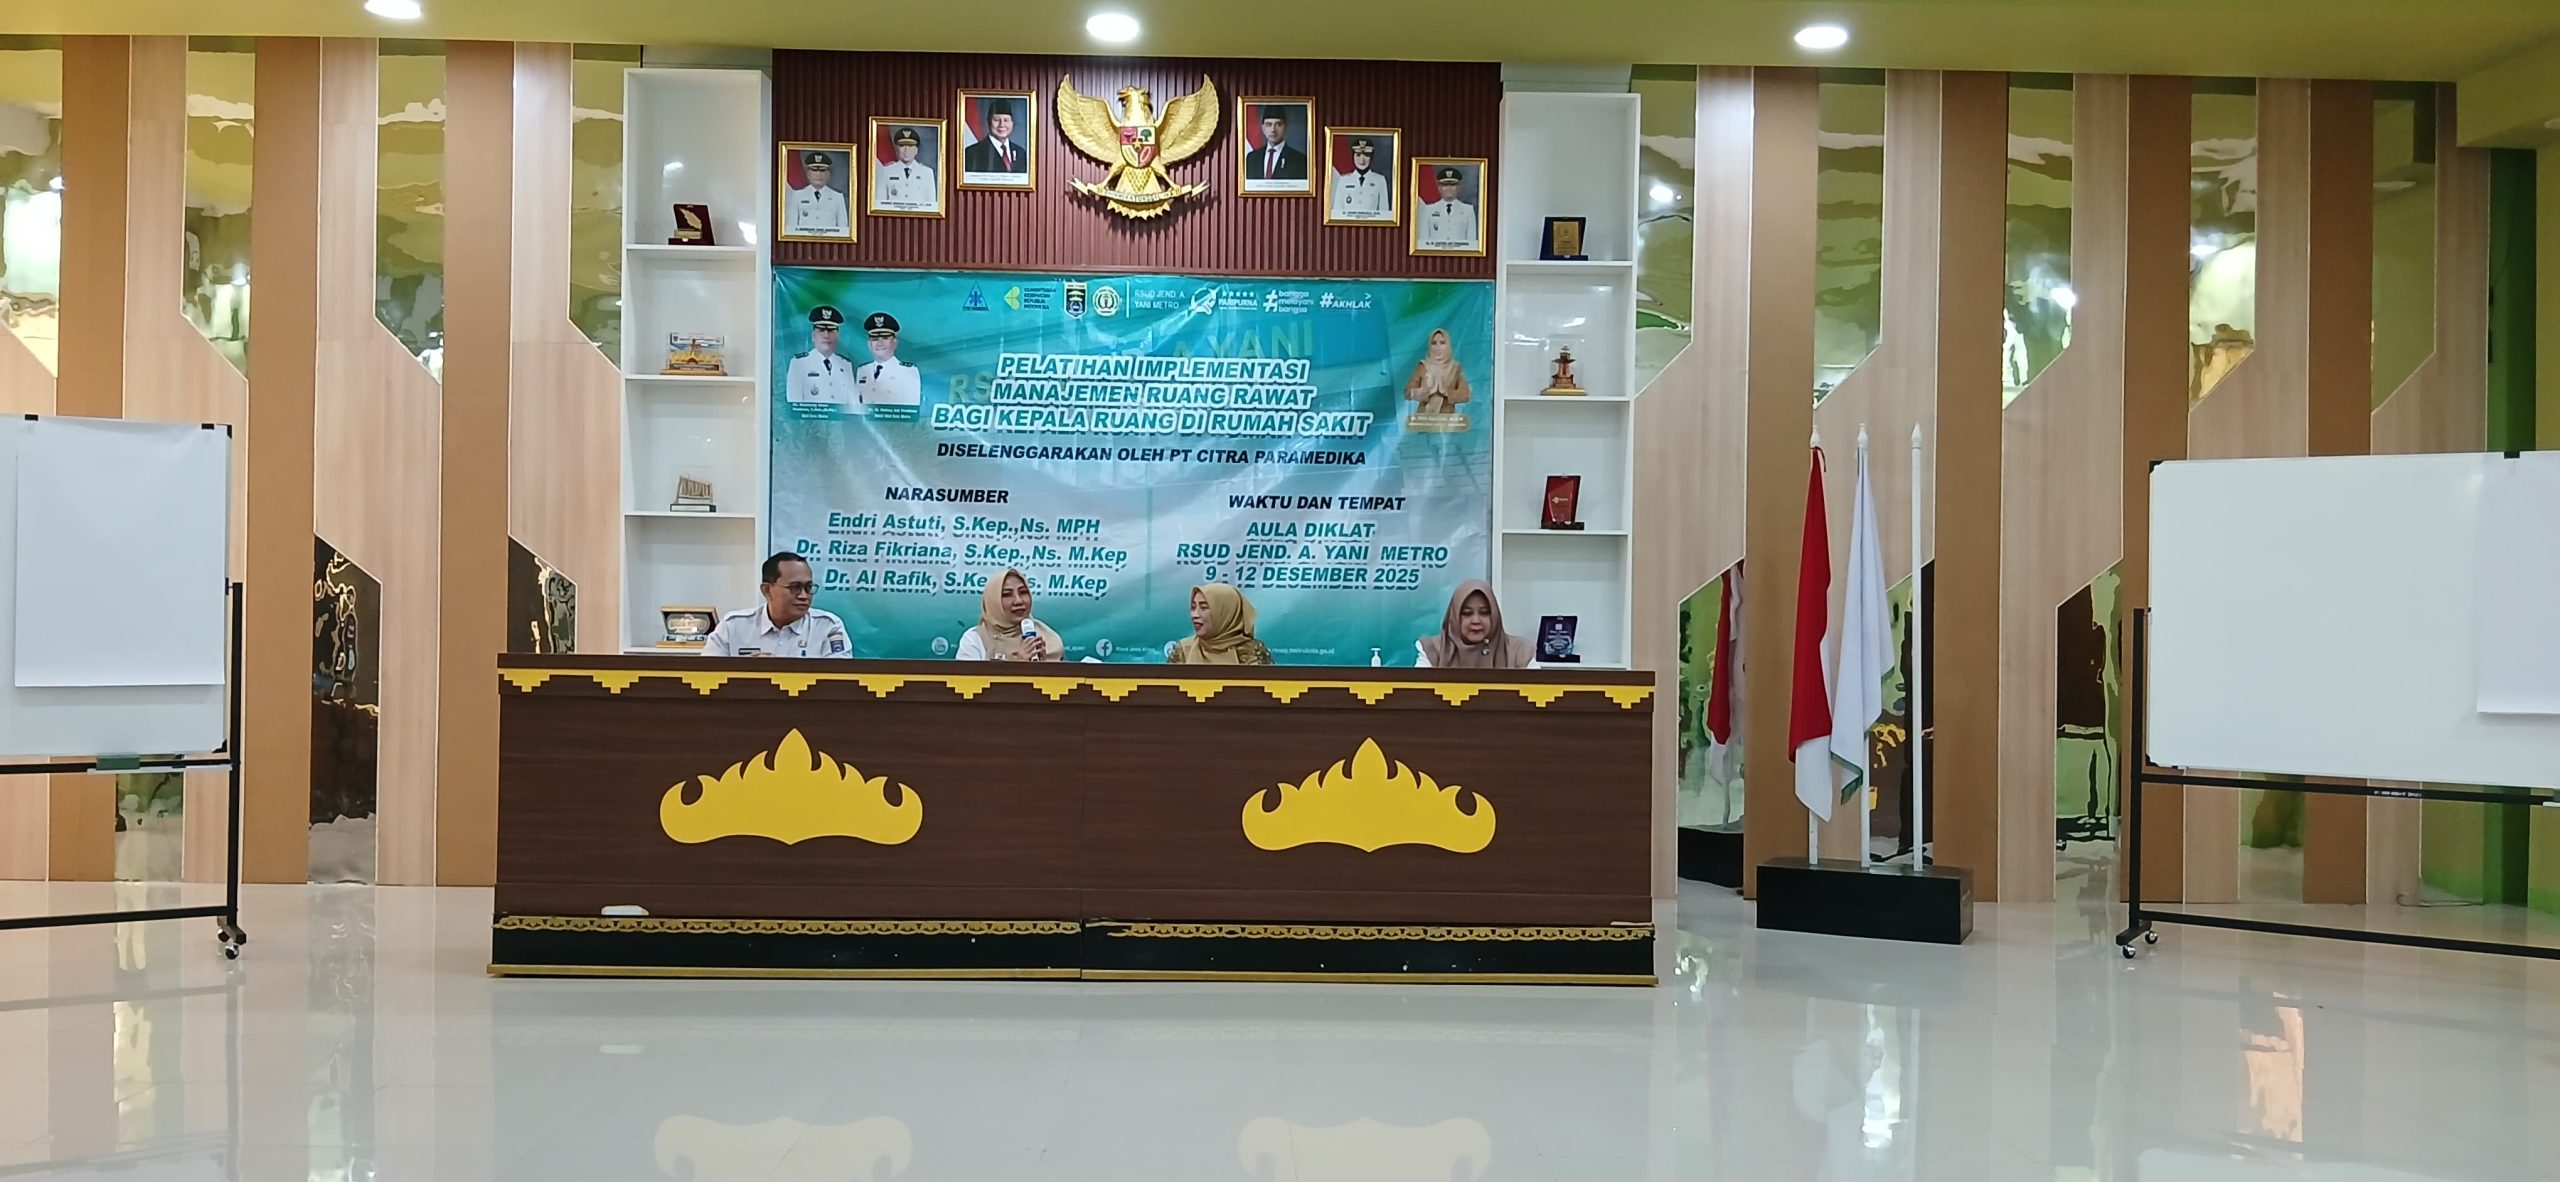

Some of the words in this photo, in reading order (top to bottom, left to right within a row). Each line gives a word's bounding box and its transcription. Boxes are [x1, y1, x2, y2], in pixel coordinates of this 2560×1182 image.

[1134, 300, 1151, 309] YANI
[1152, 301, 1180, 310] METRO
[1000, 356, 1130, 378] PELATIHAN
[1136, 359, 1308, 381] IMPLEMENTASI
[993, 382, 1140, 404] MANAJEMEN
[1146, 386, 1227, 405] RUANG
[1233, 388, 1314, 408] RAWAT
[934, 407, 990, 428] BAGI
[998, 408, 1086, 430] KEPALA
[1095, 411, 1174, 431] RUANG
[1179, 413, 1202, 432] DI
[1210, 414, 1295, 434] RUMAH
[1301, 416, 1371, 435] SAKIT
[937, 443, 1112, 461] DISELENGGARAKAN
[1117, 448, 1164, 462] OLEH
[1169, 449, 1191, 463] PT
[1197, 450, 1249, 464] CITRA
[1255, 451, 1367, 466] PARAMEDIKA
[885, 487, 1009, 504] NARASUMBER
[1229, 495, 1293, 510] WAKTU
[1297, 496, 1333, 510] DAN
[1338, 496, 1406, 511] TEMPAT
[828, 512, 877, 529] Endri
[882, 514, 946, 533] Astuti,
[1056, 518, 1101, 534] MPH
[1246, 521, 1298, 538] AULA
[1304, 522, 1375, 539] DIKLAT
[796, 539, 821, 555] Dr.
[828, 540, 868, 556] Riza
[874, 541, 957, 560] Fikriana,
[1068, 546, 1128, 564] M.Kep
[1176, 543, 1230, 559] RSUD
[1236, 544, 1292, 560] JEND.
[1297, 545, 1317, 560] A.
[1325, 545, 1370, 561] YANI
[1380, 546, 1449, 562] METRO
[824, 569, 850, 586] Dr.
[855, 570, 877, 586] Al
[883, 570, 938, 589] Rafik,
[1048, 574, 1108, 594] M.Kep
[1204, 566, 1218, 581] 9
[1234, 566, 1258, 582] 12
[1262, 567, 1368, 583] DESEMBER
[1373, 568, 1420, 584] 2025
